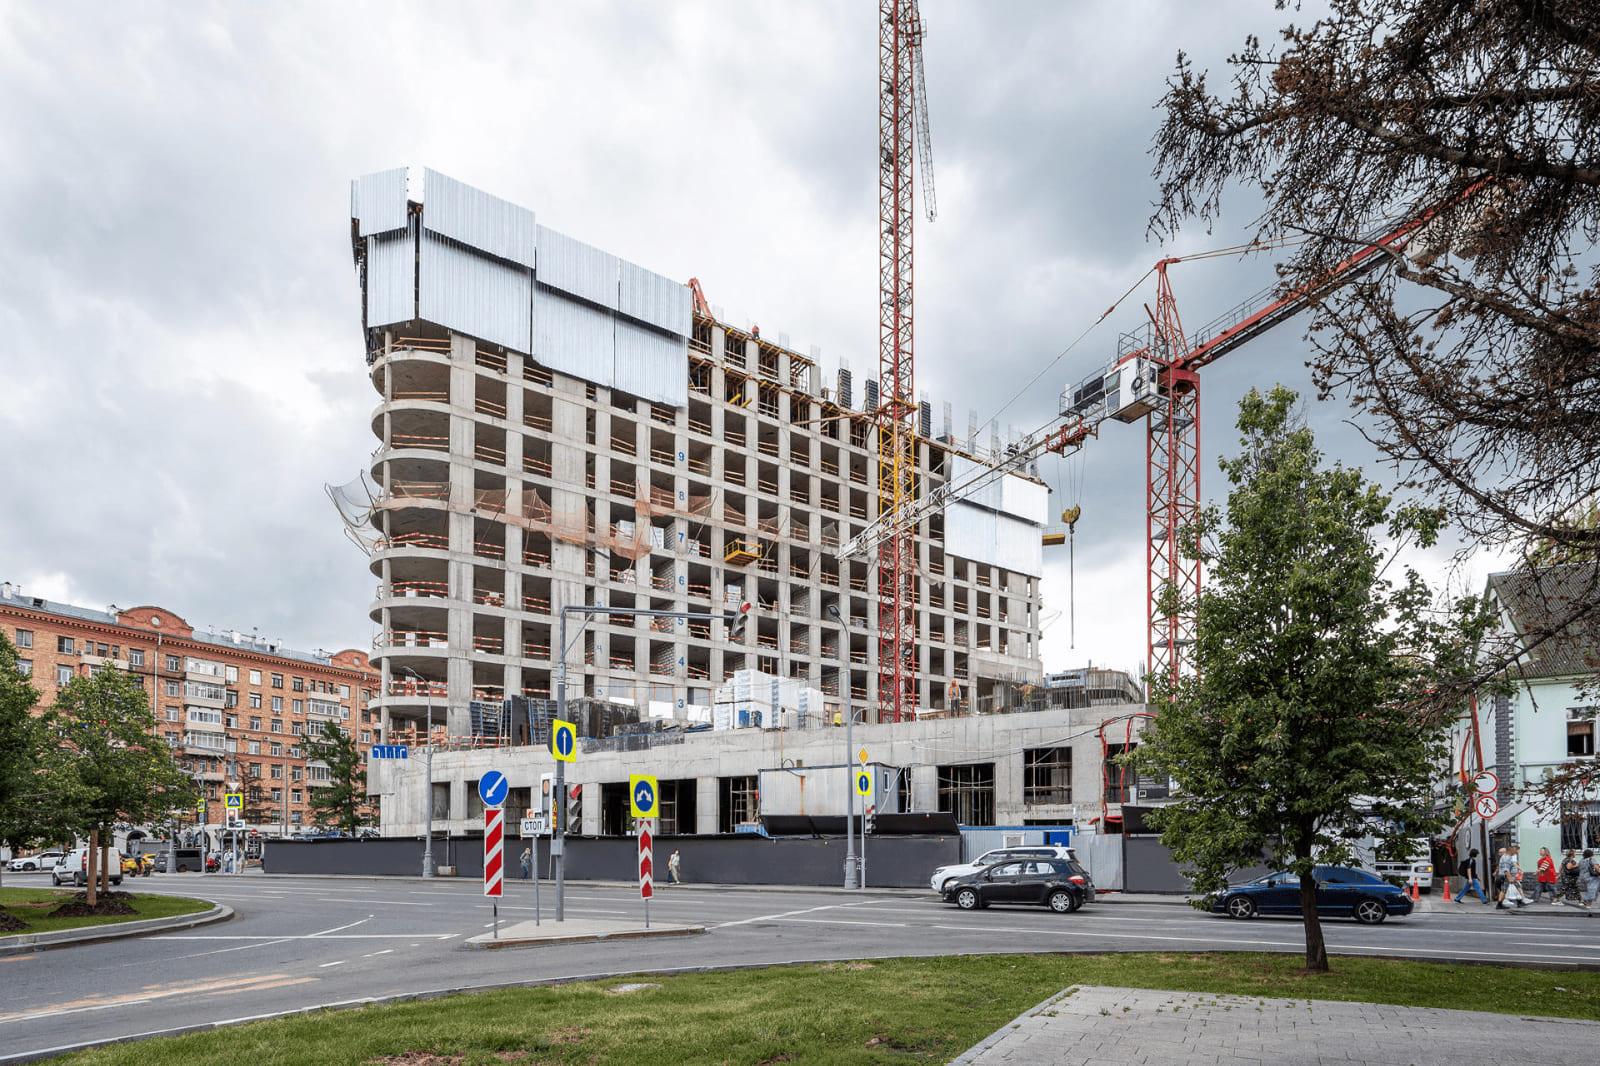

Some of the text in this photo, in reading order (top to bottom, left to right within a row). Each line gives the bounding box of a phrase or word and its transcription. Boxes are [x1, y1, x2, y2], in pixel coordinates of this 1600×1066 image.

[678, 451, 685, 462] 9
[678, 491, 685, 501] 8
[678, 532, 685, 543] 7
[678, 575, 685, 586] 6
[677, 617, 684, 626] 5
[678, 656, 685, 667] 4
[678, 698, 684, 708] 3
[524, 821, 542, 831] СТОП
